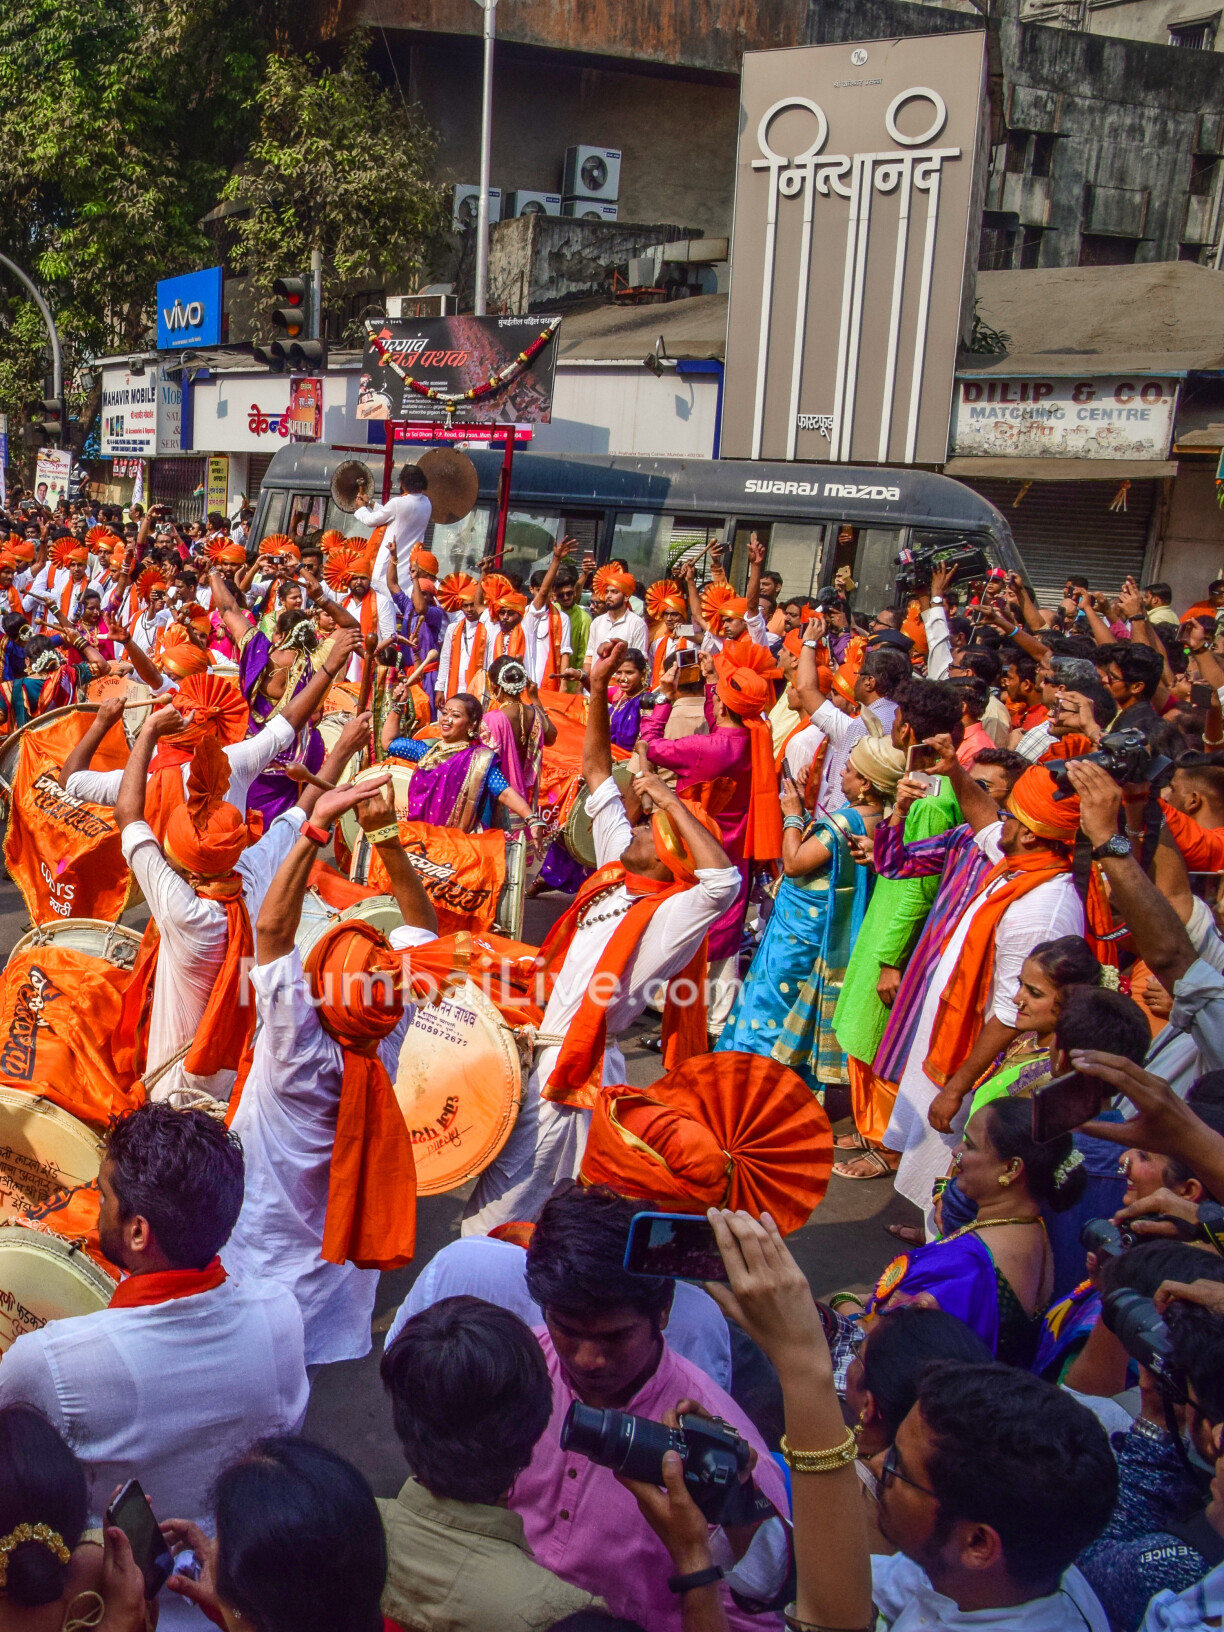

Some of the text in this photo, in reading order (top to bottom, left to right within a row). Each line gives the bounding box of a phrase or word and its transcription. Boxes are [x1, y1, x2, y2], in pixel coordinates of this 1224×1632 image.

[163, 298, 204, 331] vivo
[420, 350, 471, 368] पथक
[103, 387, 156, 407] MAHAVIR MOBILE
[161, 387, 182, 405] MOB
[962, 381, 1169, 405] DILIP & CO.
[166, 411, 181, 421] SAL
[969, 406, 1152, 421] MATCHING CENTRE
[797, 413, 834, 443] फास्टफूड
[161, 439, 181, 449] SERV
[410, 1127, 440, 1145] पथ
